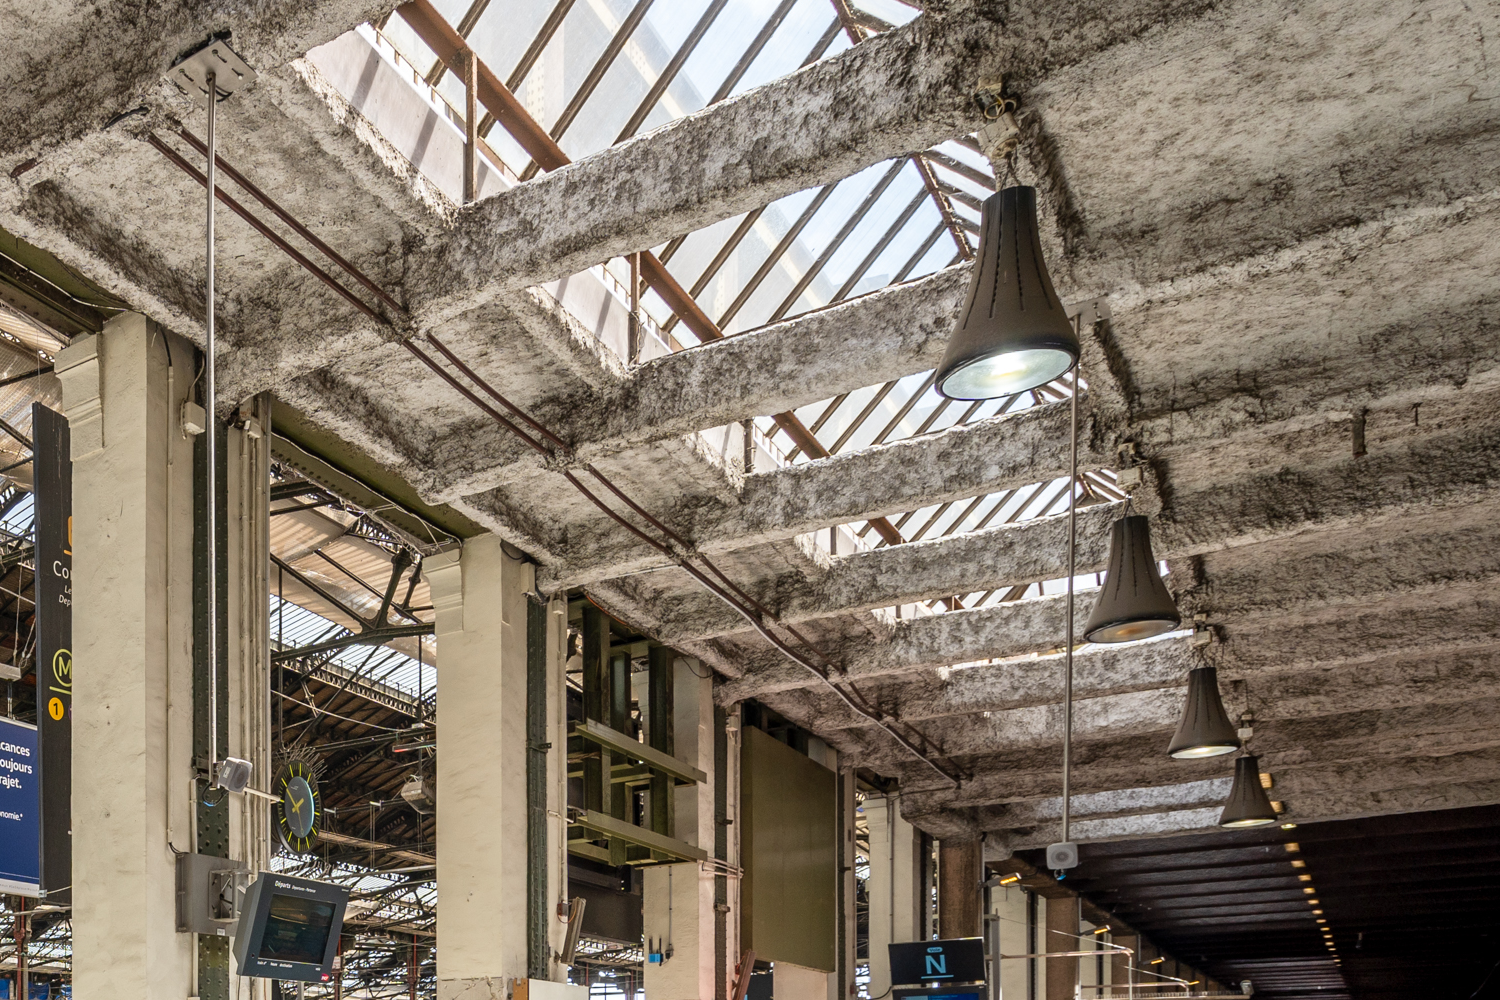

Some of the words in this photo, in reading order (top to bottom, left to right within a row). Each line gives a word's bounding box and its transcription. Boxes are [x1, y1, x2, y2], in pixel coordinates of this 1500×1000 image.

[53, 560, 72, 580] Co
[53, 703, 59, 716] 1
[275, 880, 291, 889] Départs
[925, 954, 946, 975] N
